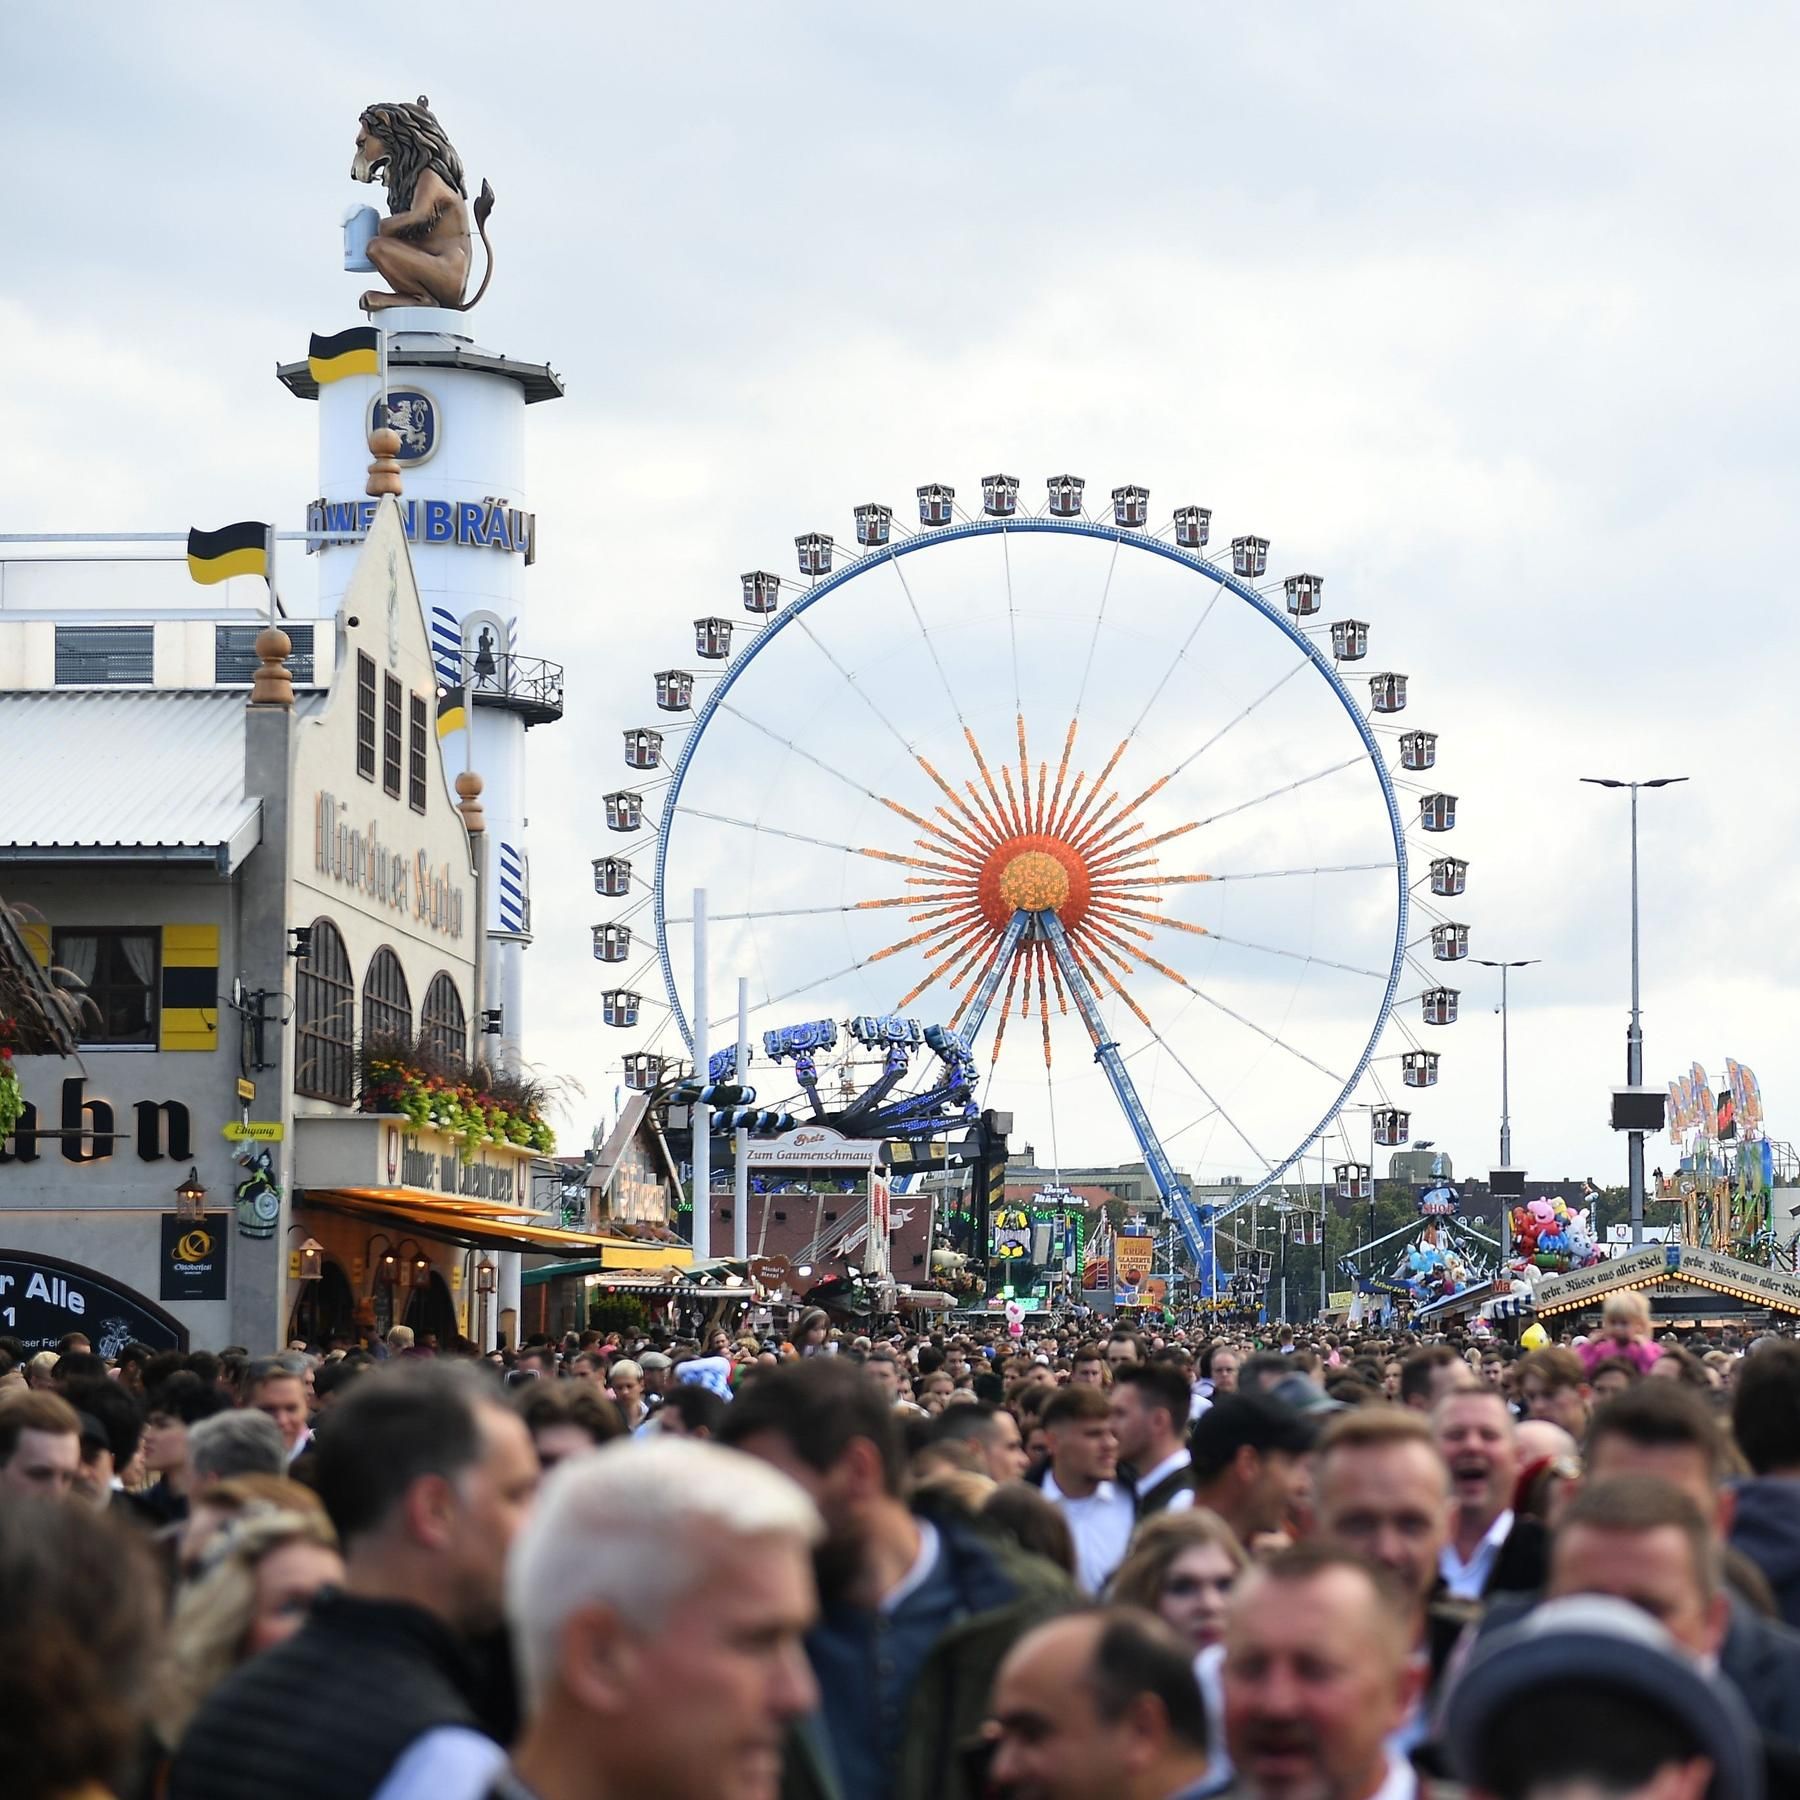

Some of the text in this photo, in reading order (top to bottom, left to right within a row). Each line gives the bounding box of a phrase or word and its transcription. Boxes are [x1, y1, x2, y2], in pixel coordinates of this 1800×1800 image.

[307, 496, 534, 556] ÖWENBRÄU
[747, 1149, 873, 1161] Zum Gaumenschmaus
[1423, 1203, 1455, 1215] SHOP
[1597, 1270, 1615, 1283] aus
[1616, 1262, 1637, 1277] aller
[25, 1272, 86, 1315] Alle
[1758, 1277, 1781, 1291] aller
[3, 1306, 16, 1327] 1
